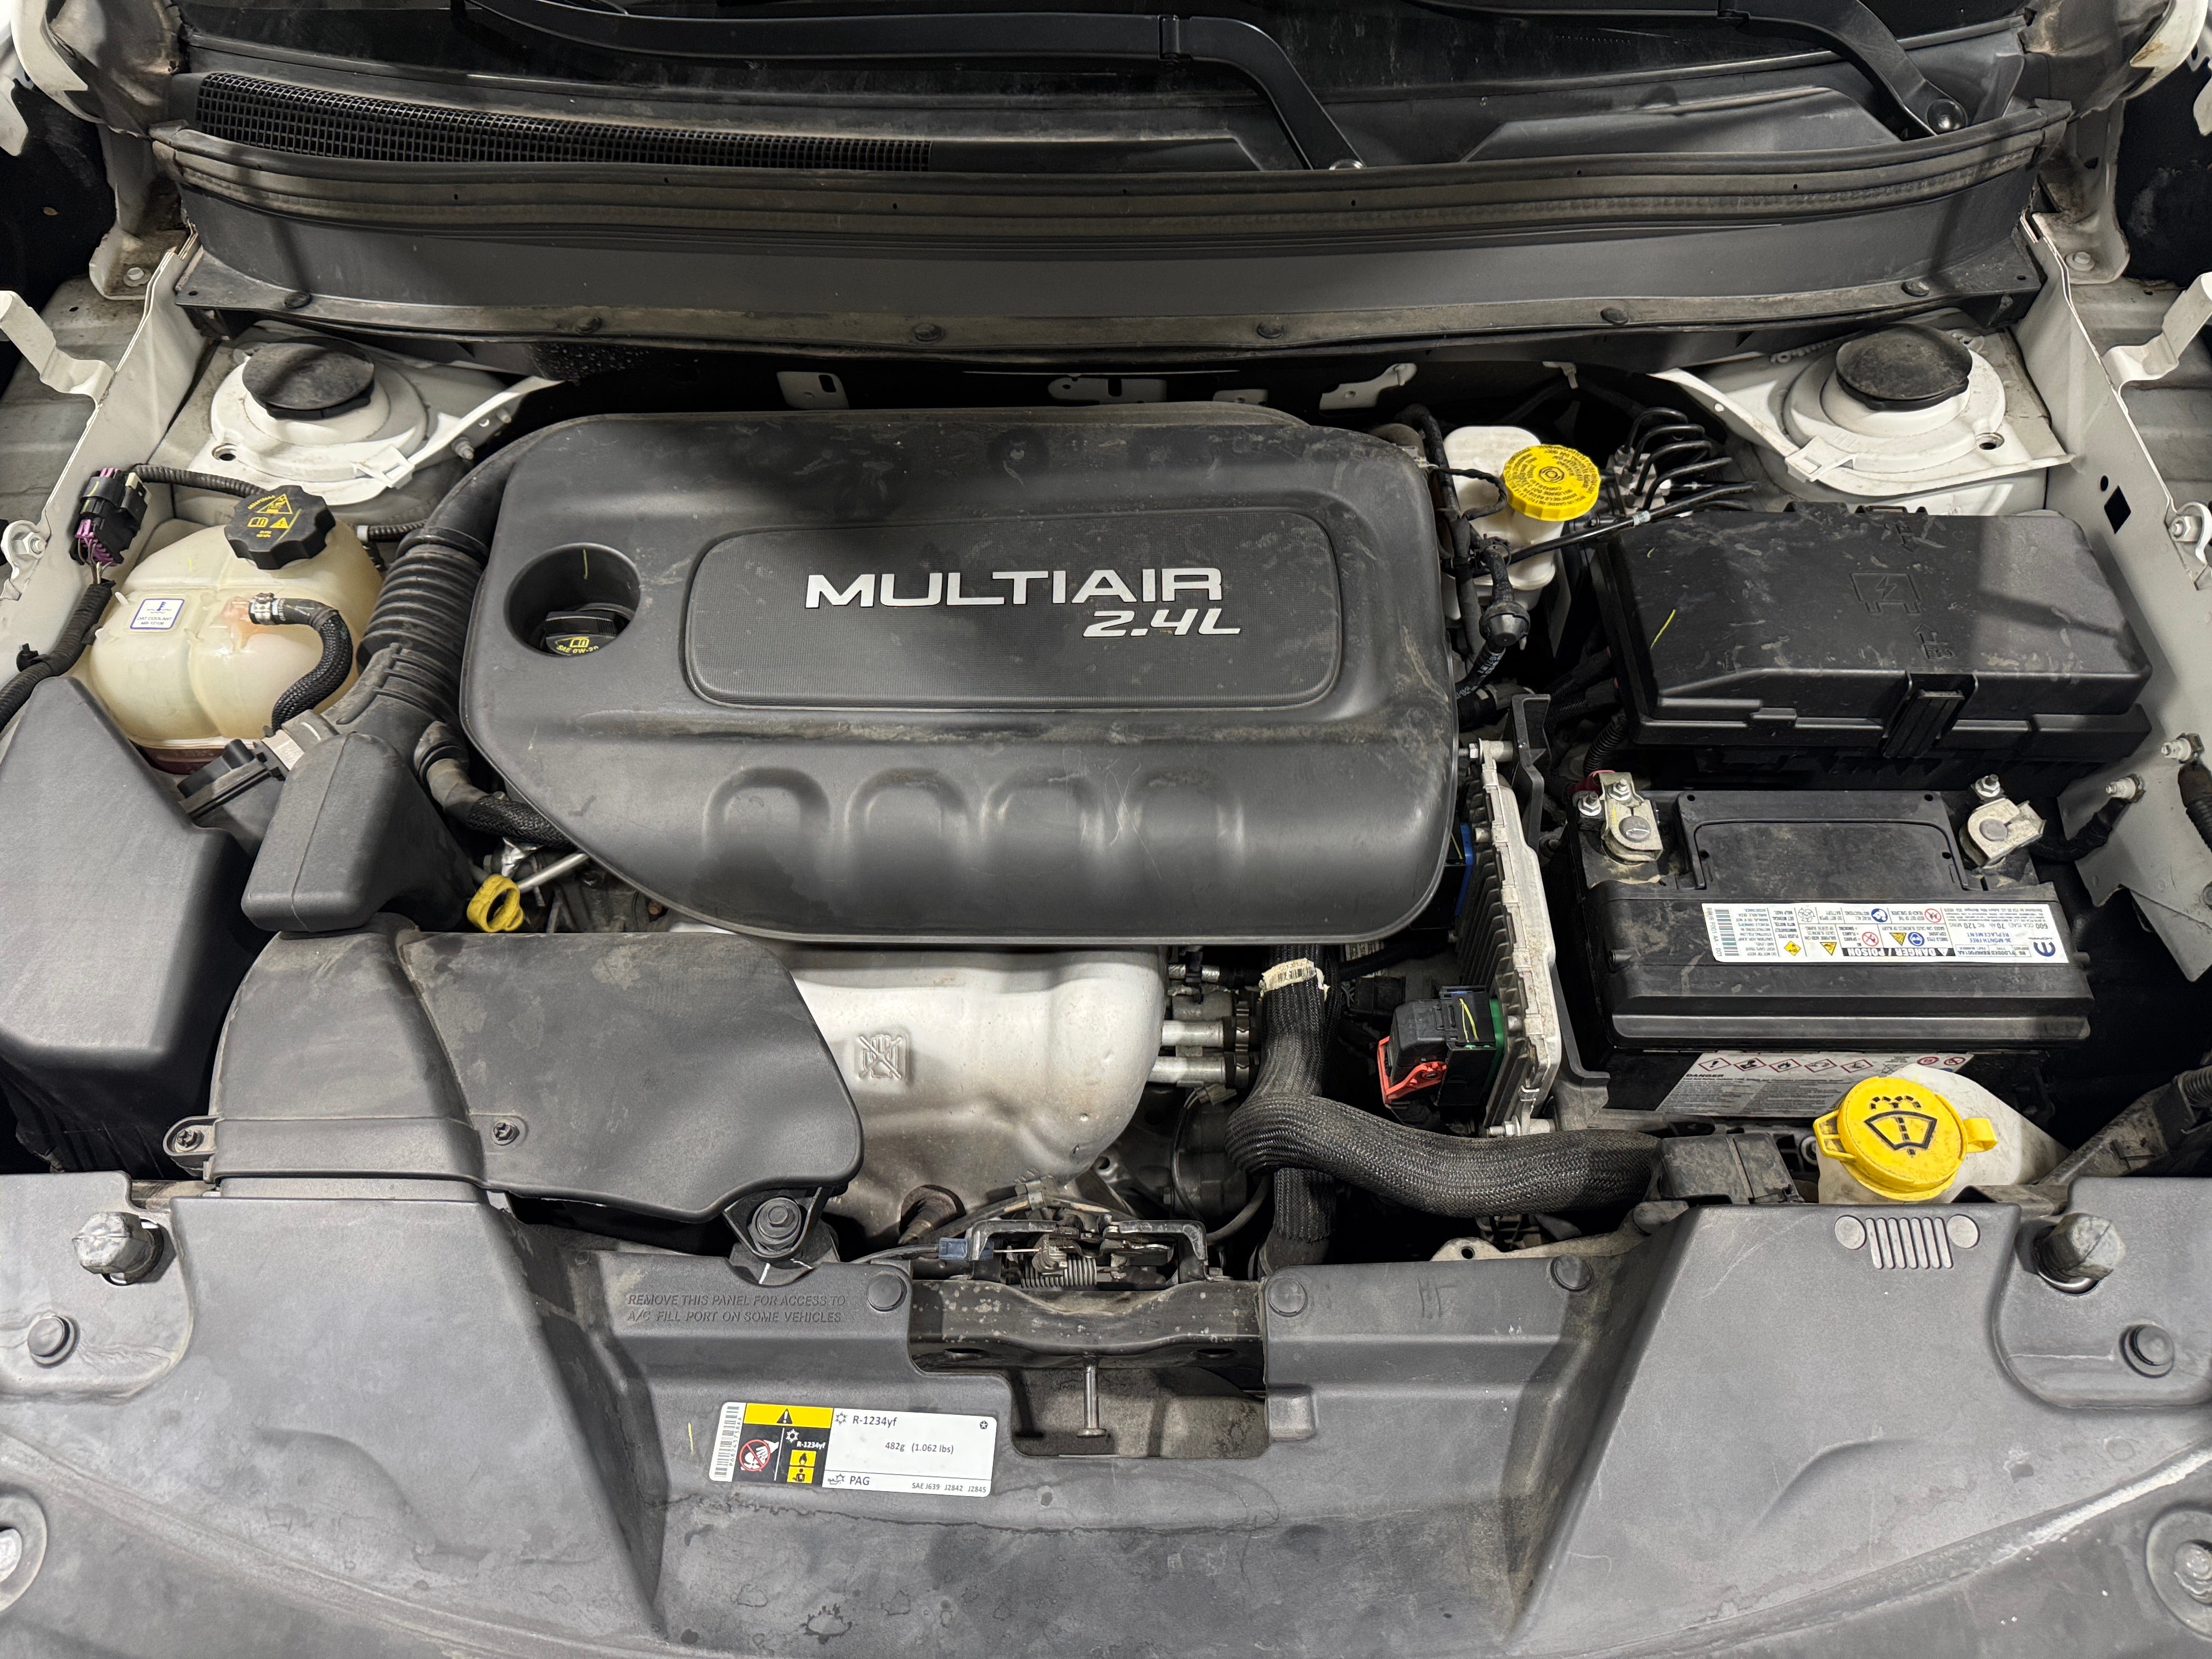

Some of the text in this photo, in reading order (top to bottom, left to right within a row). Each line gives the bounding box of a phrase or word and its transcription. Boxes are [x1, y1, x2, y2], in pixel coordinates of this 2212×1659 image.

[805, 568, 1222, 609] MULTIAIR
[1082, 608, 1241, 637] 2.4L
[1847, 948, 1885, 956] POISON
[1895, 948, 1936, 956] DANGER
[628, 1295, 845, 1305] REMOVE THIS PANEL FOR ACCESS TO
[628, 1311, 841, 1323] A/C FILL PORT ON SOME VEHICLES
[853, 1415, 897, 1428] R-1234yf
[797, 1440, 826, 1449] R-1234yf
[885, 1442, 954, 1454] 482g (1.062 lbs)
[850, 1475, 870, 1486] PAG
[911, 1482, 925, 1490] SAE
[925, 1482, 940, 1491] J639
[967, 1484, 986, 1493] J2845
